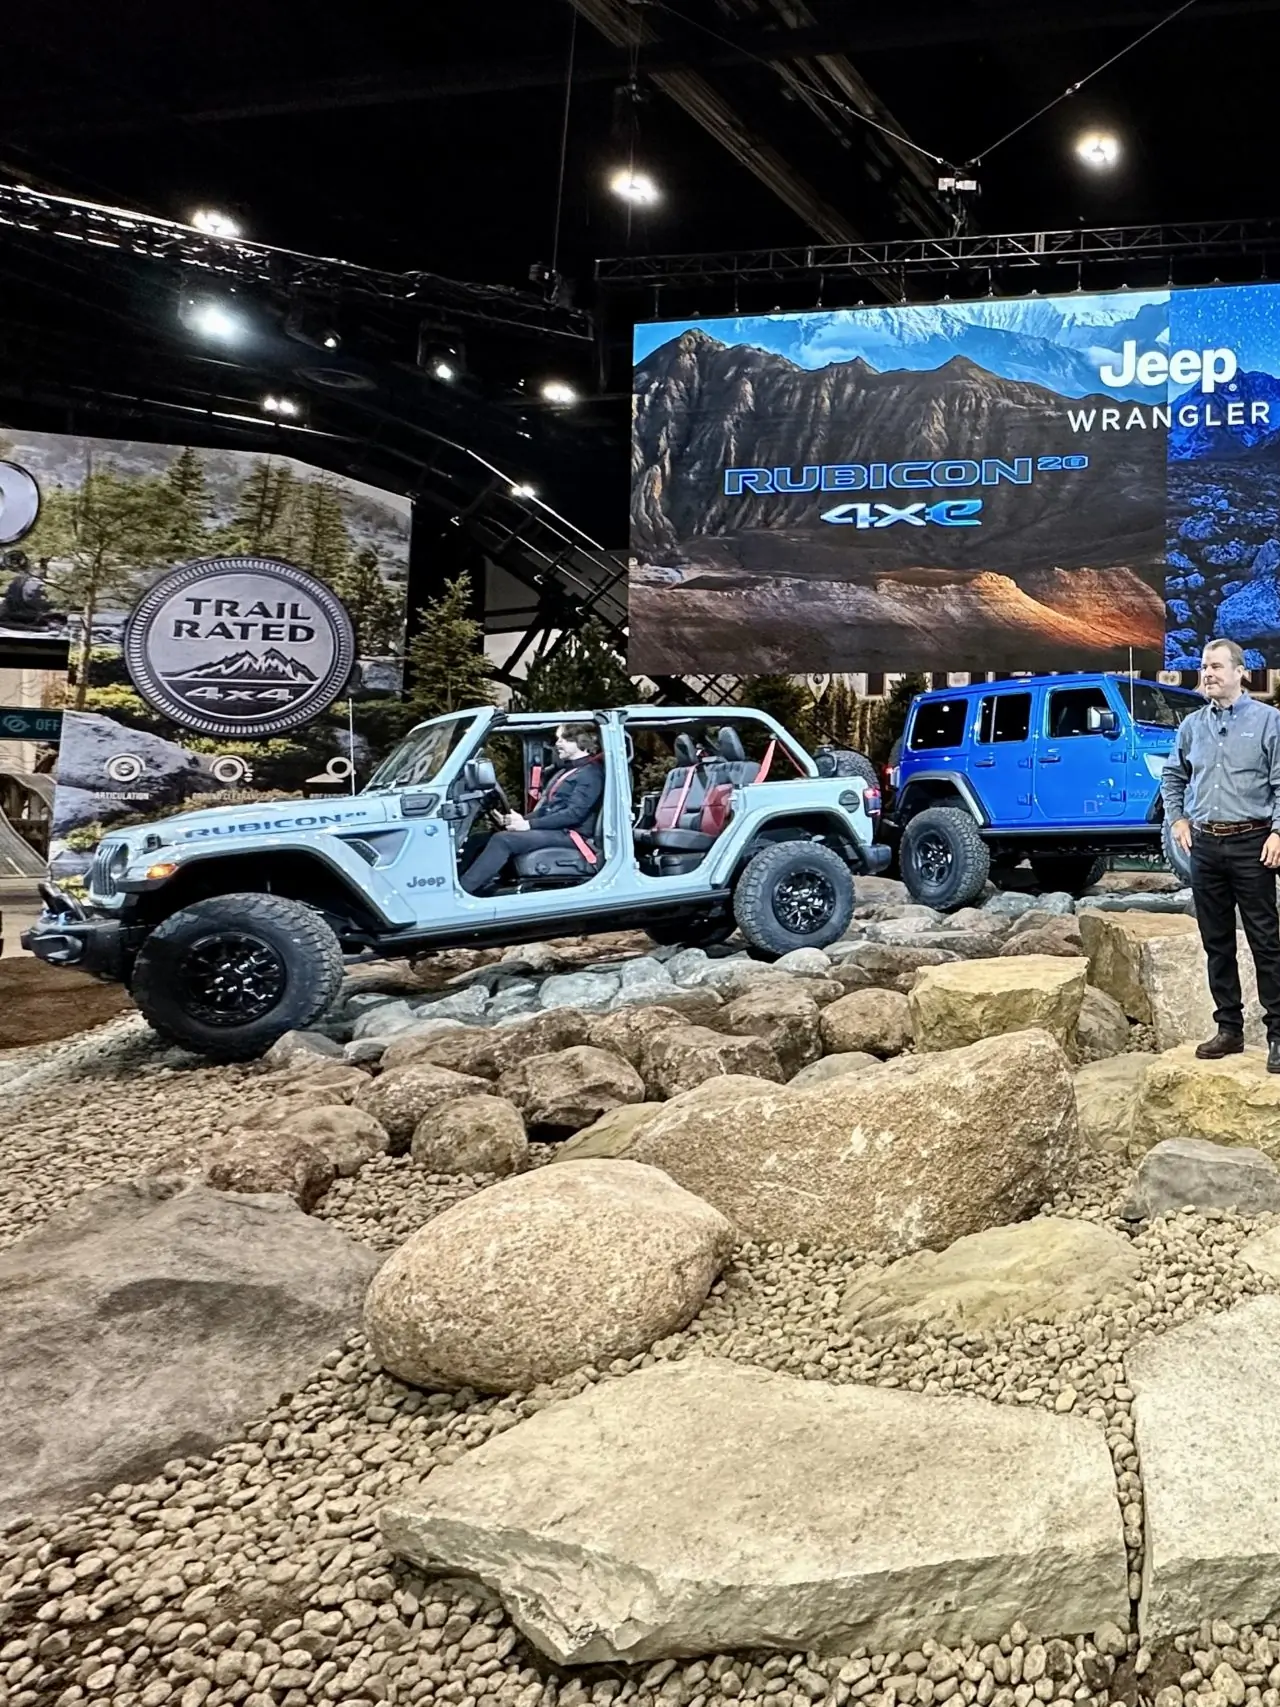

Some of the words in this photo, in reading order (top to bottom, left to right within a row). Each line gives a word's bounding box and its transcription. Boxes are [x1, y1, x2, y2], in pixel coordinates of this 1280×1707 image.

[1100, 340, 1237, 393] Jeep
[1067, 402, 1270, 433] WRANGLER
[724, 457, 1032, 495] RUBICON
[185, 598, 312, 621] TRAIL
[173, 620, 315, 642] RATED
[185, 686, 294, 701] 4x4
[184, 814, 341, 838] RUBICON
[406, 876, 446, 888] Jeep
